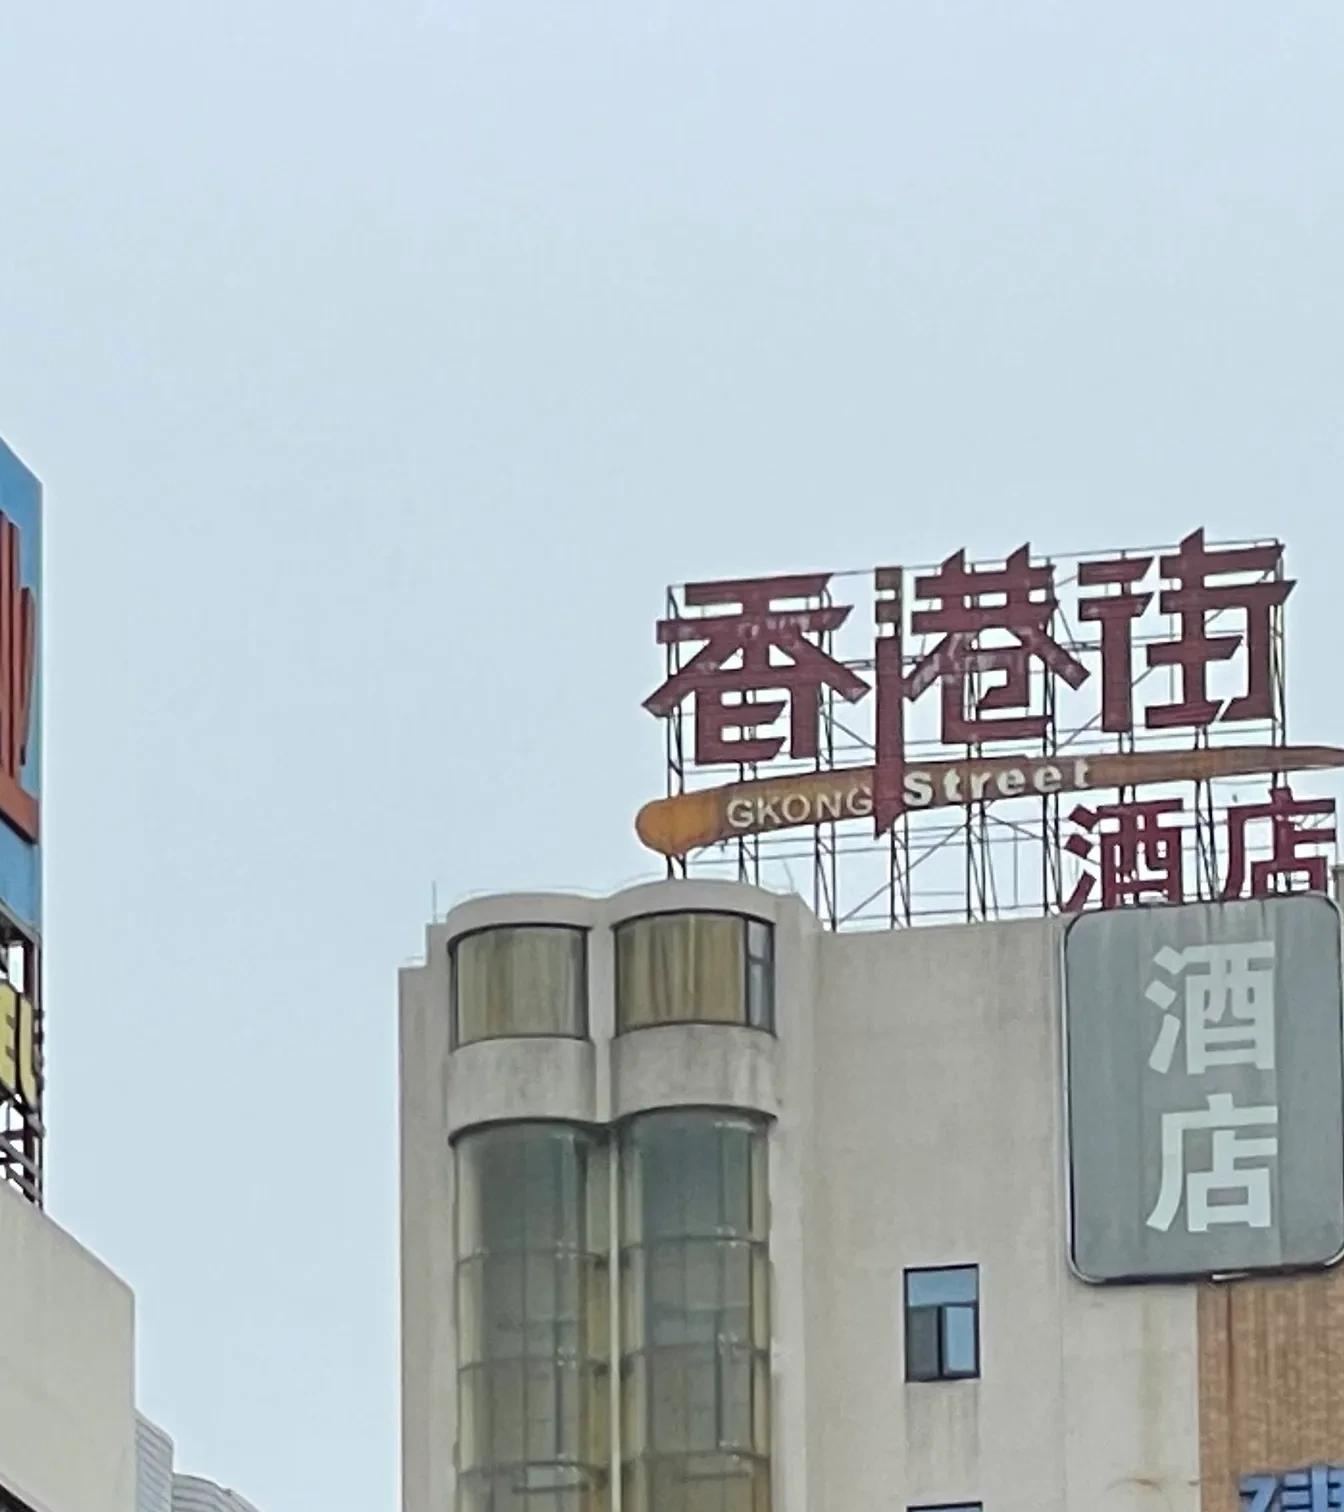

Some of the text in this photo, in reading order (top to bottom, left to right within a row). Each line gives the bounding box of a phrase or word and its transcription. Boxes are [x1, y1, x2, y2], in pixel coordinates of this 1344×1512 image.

[641, 526, 1298, 838] 香港街
[902, 757, 1090, 808] Street
[1060, 787, 1337, 913] 酒店
[1144, 940, 1279, 1233] 酒店
